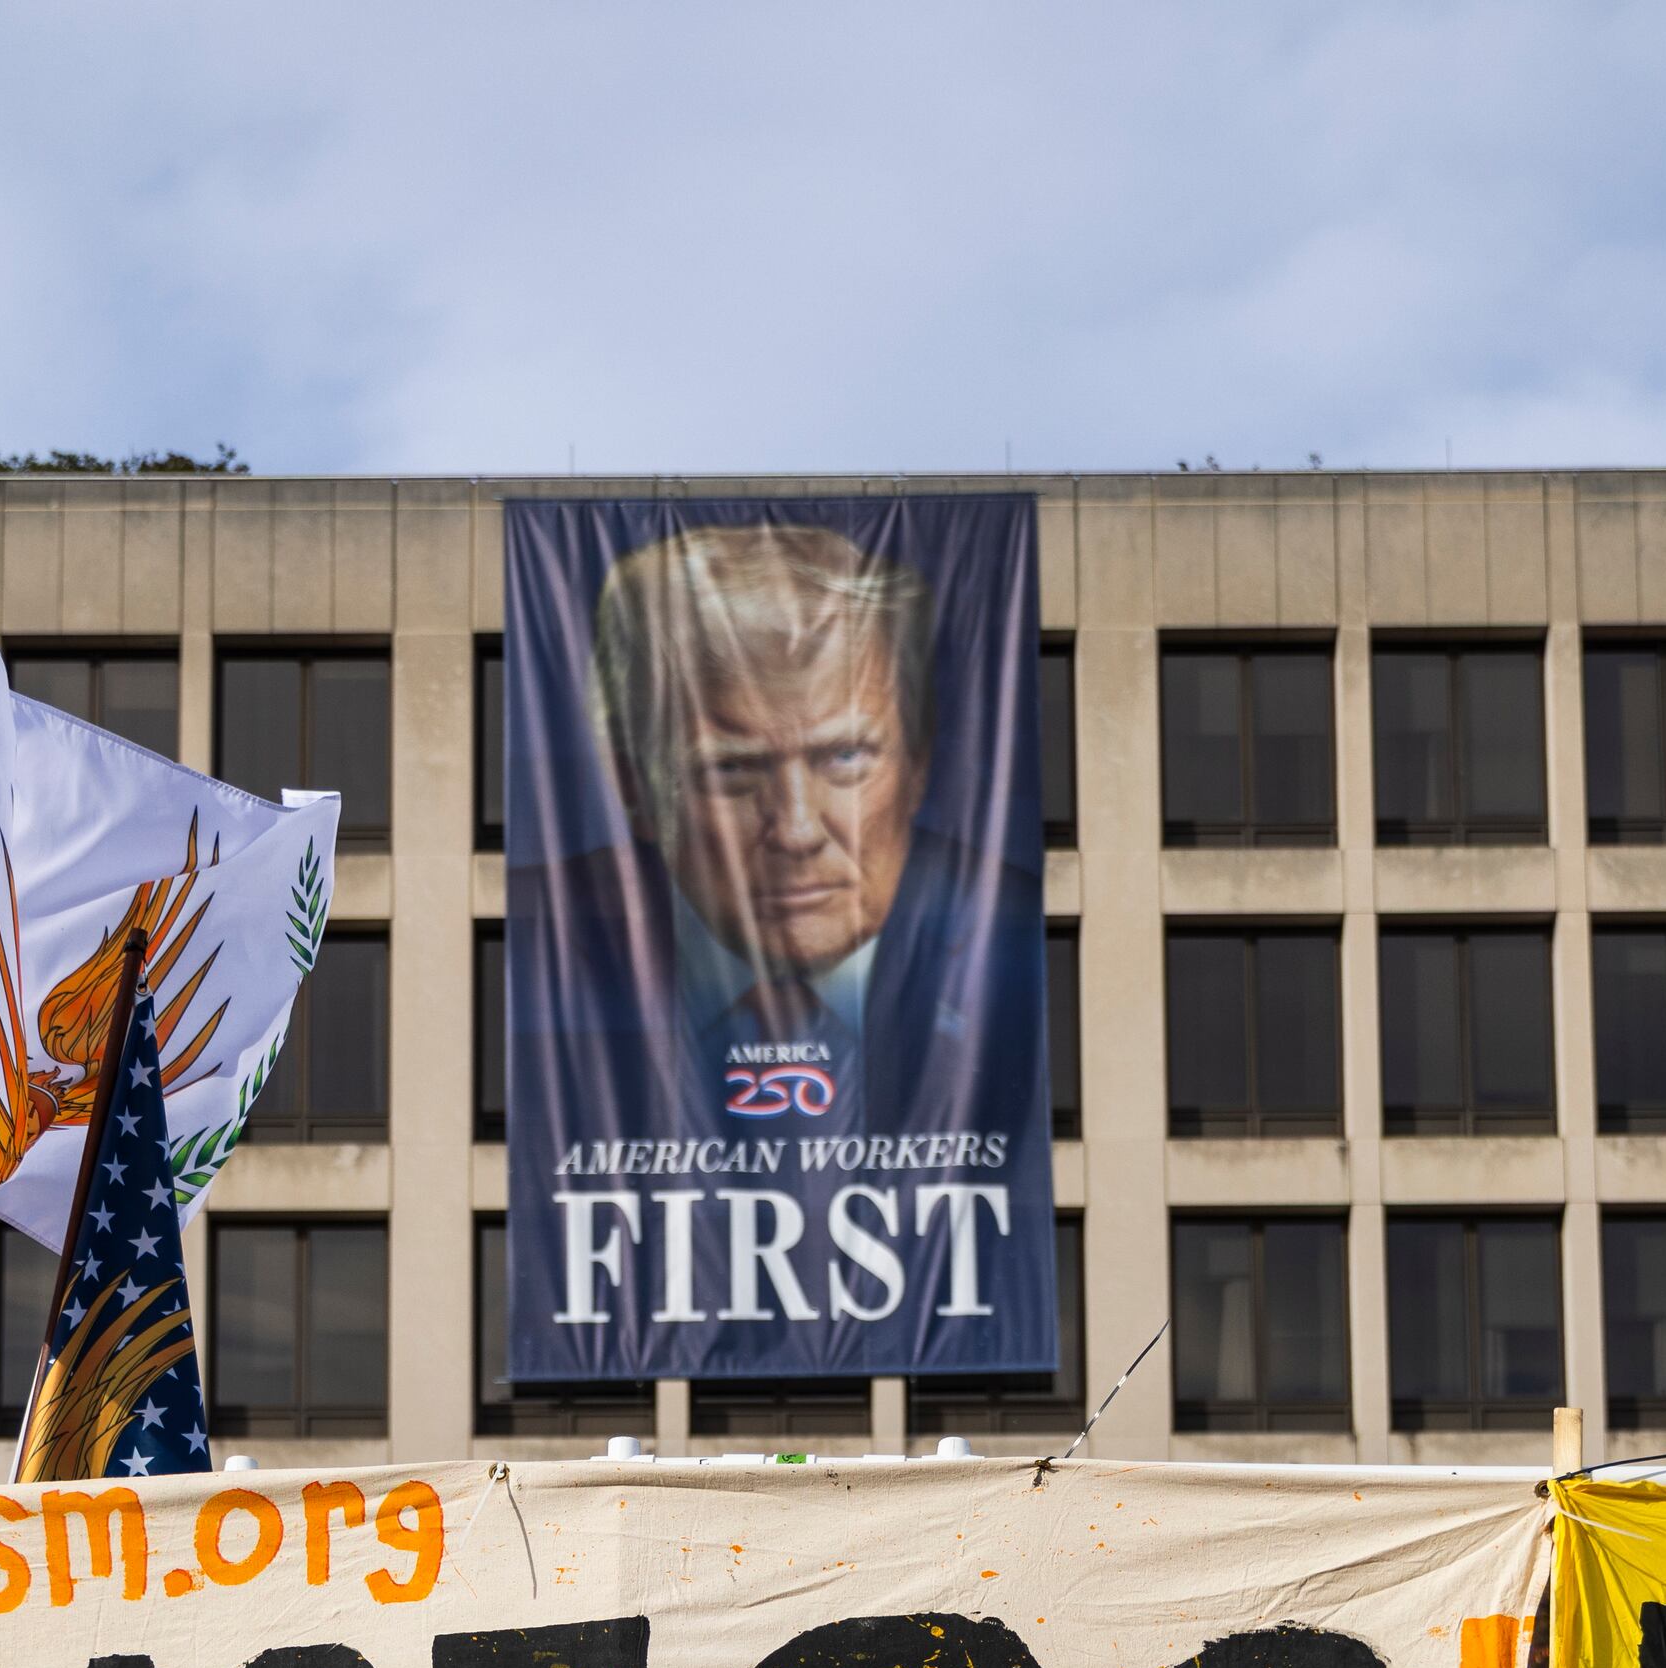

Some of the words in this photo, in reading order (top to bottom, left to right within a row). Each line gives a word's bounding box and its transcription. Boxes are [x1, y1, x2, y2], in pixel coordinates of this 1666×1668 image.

[727, 1042, 831, 1064] AMERICA
[725, 1064, 834, 1118] 250
[554, 1136, 785, 1176] AMERICAN
[799, 1132, 1008, 1172] WORKERS
[553, 1184, 1011, 1325] FIRST
